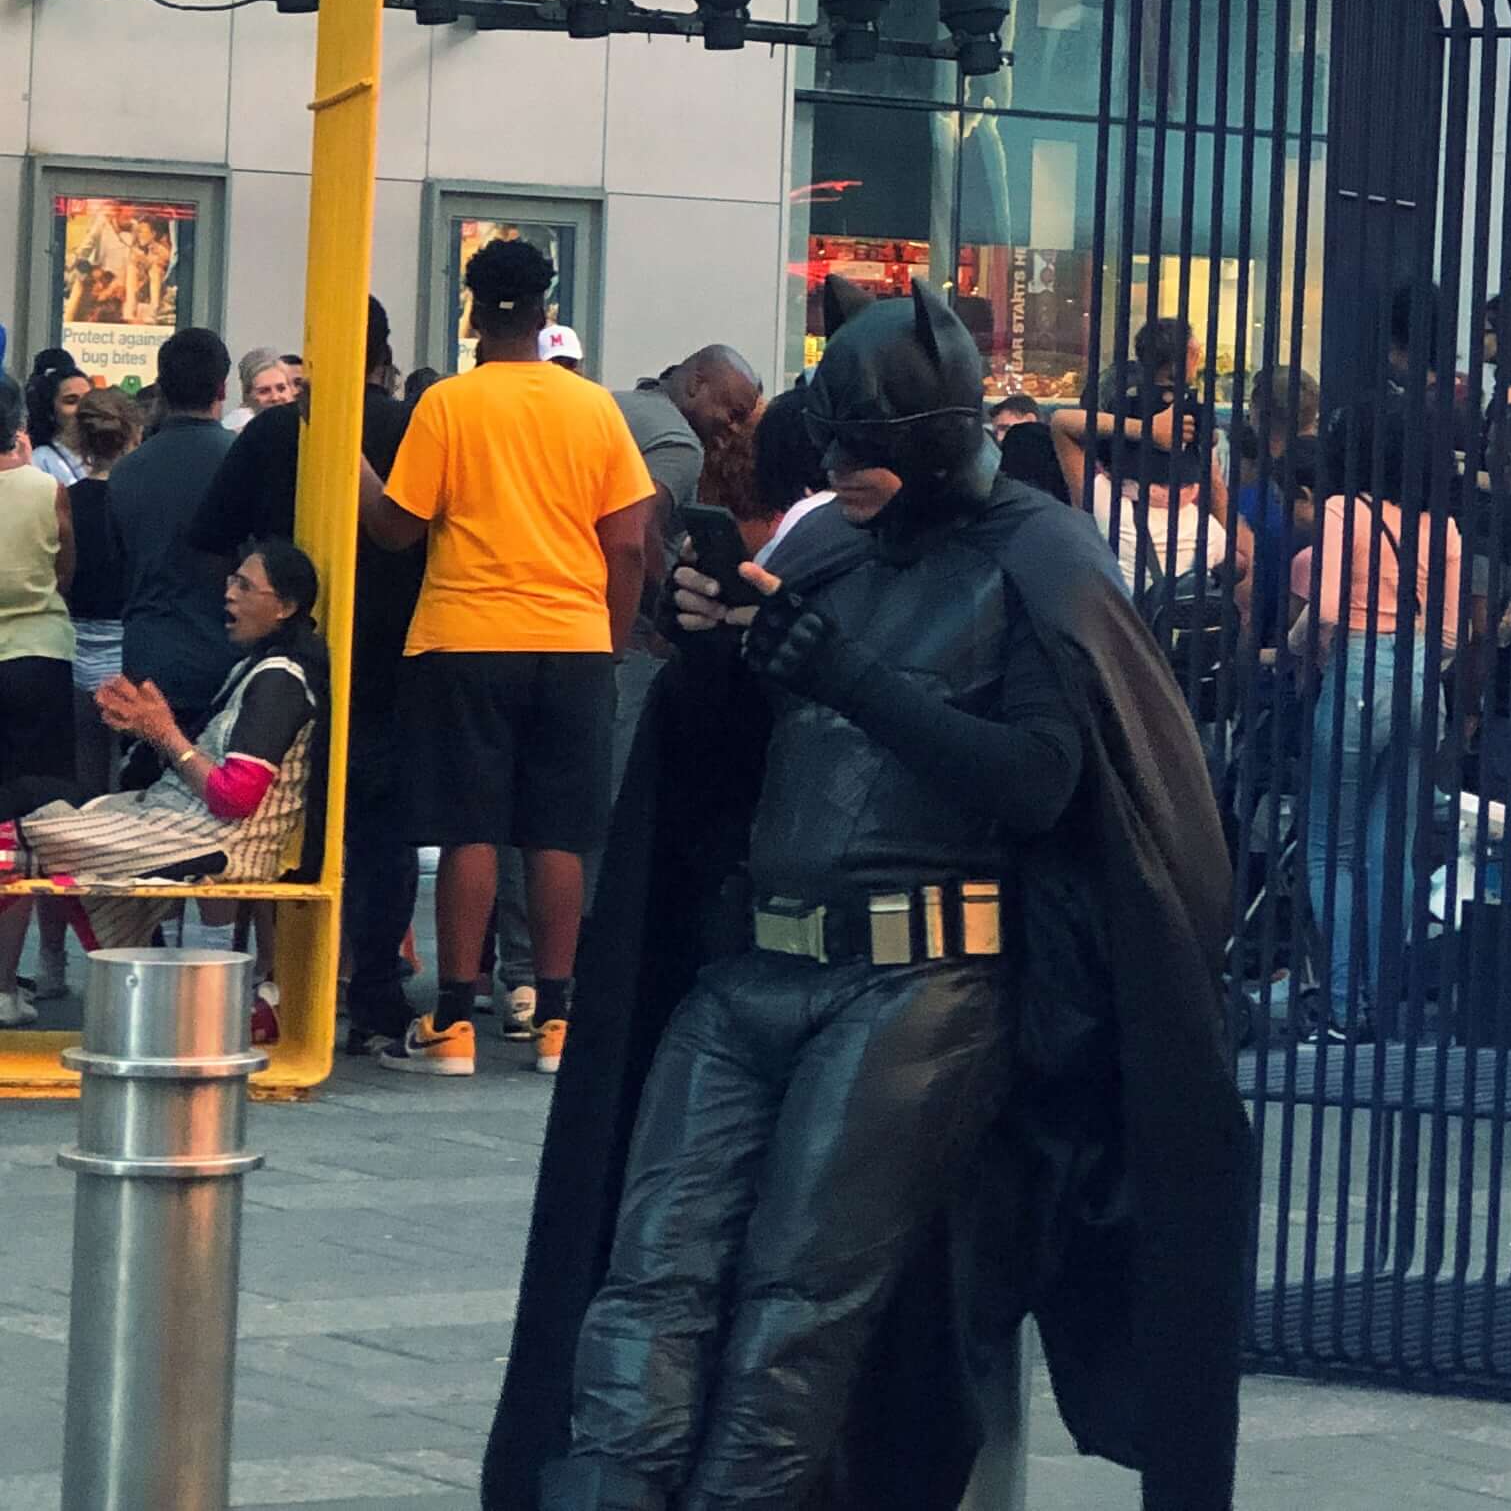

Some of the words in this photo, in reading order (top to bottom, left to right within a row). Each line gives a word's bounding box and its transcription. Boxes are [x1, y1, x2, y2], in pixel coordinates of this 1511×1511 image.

[63, 328, 115, 345] Protect
[549, 333, 564, 347] M
[82, 350, 109, 368] bug
[112, 350, 147, 366] bites
